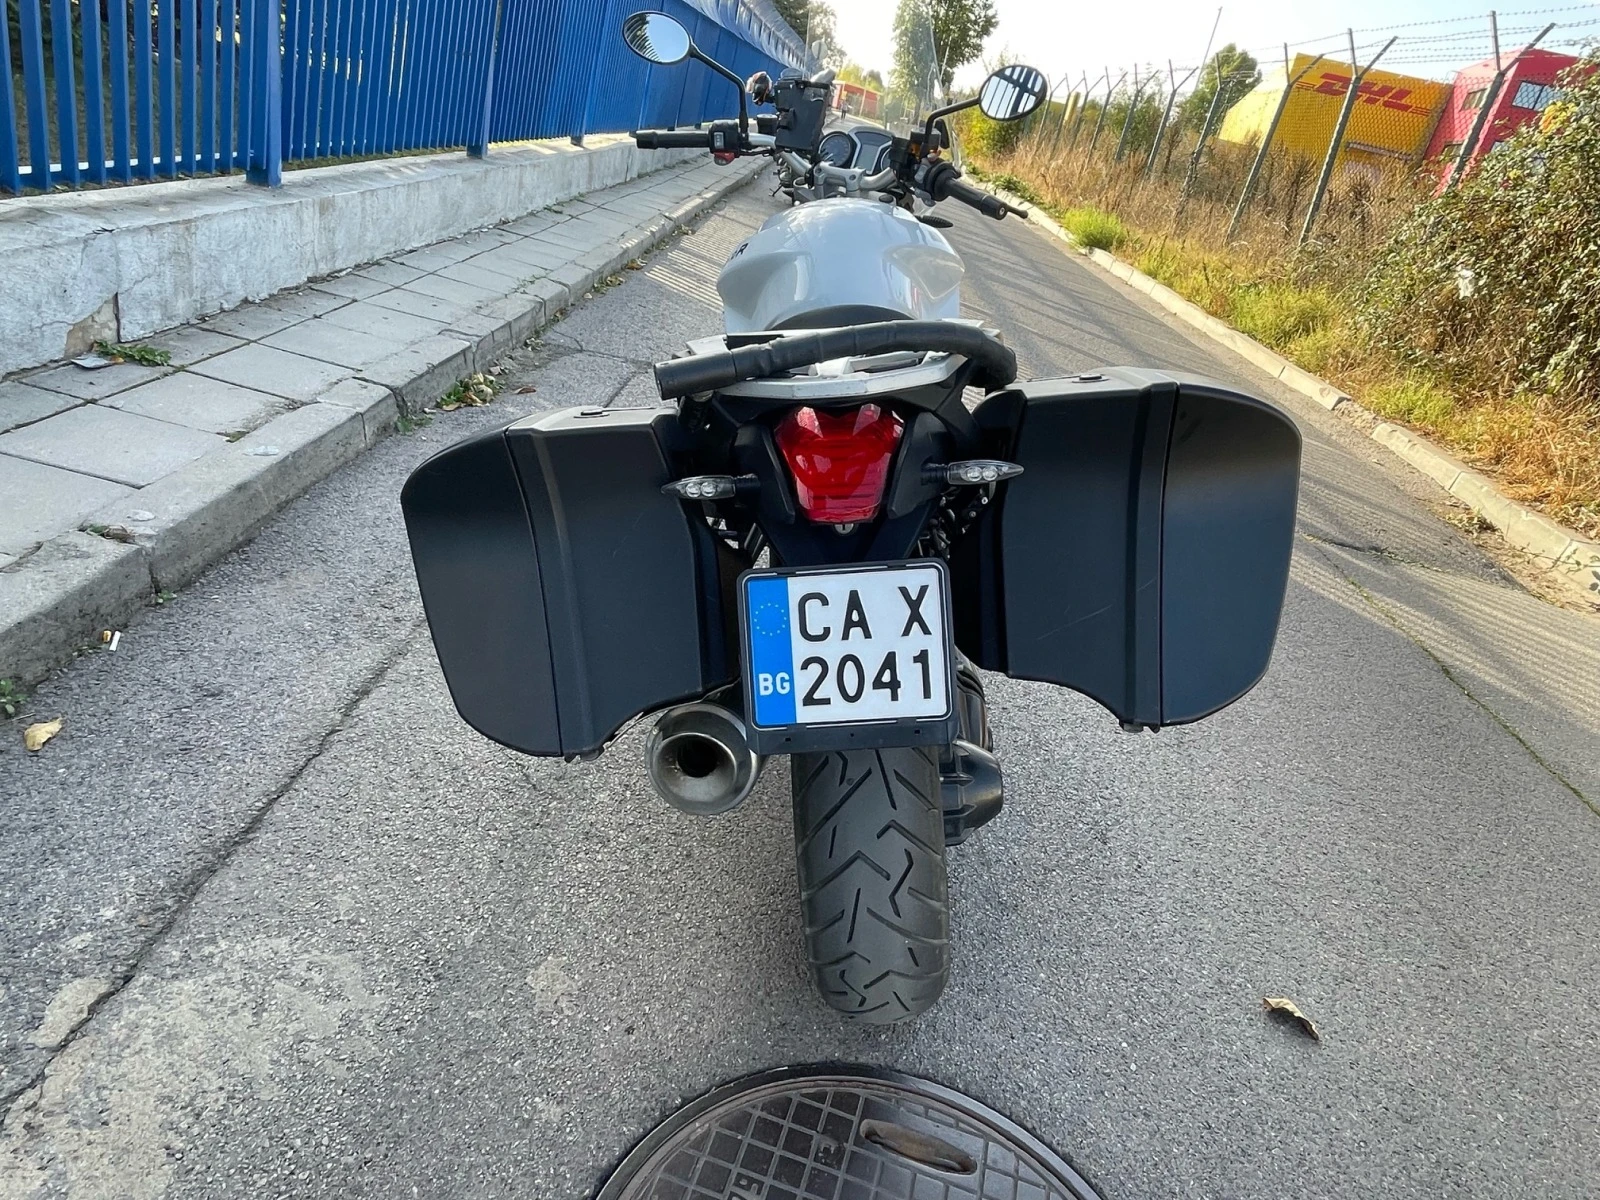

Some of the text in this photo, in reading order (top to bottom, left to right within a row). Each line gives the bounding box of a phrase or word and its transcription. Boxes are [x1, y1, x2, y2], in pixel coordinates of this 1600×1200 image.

[1314, 72, 1414, 112] DHL
[798, 584, 932, 642] CA X
[758, 671, 790, 696] BG
[800, 648, 931, 706] 2041
